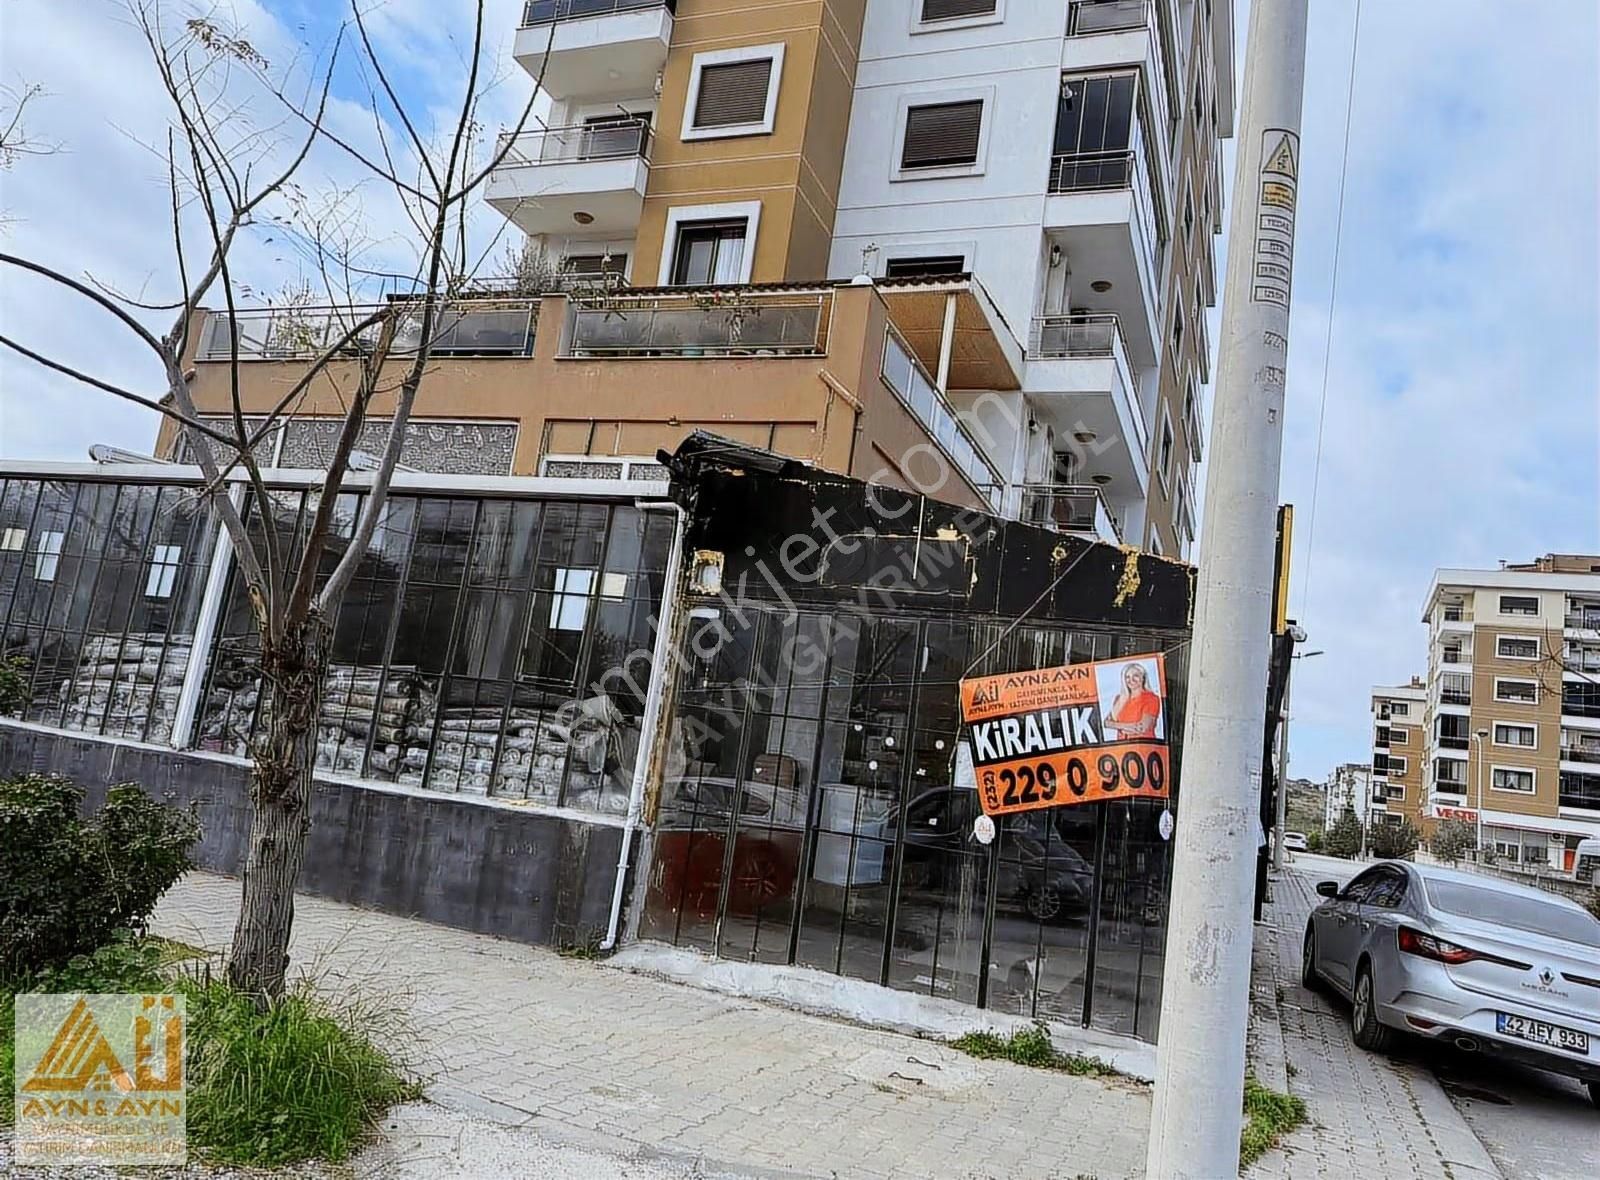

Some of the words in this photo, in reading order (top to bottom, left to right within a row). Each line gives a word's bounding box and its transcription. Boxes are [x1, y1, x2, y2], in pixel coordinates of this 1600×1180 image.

[973, 706, 1098, 762] KiRALIK
[984, 770, 999, 810] (232)
[1000, 762, 1057, 806] 229
[1066, 757, 1088, 796] 0
[1098, 751, 1164, 792] 900
[1507, 1016, 1524, 1034] 42
[1528, 1022, 1554, 1040] AEY
[1559, 1029, 1586, 1048] 933
